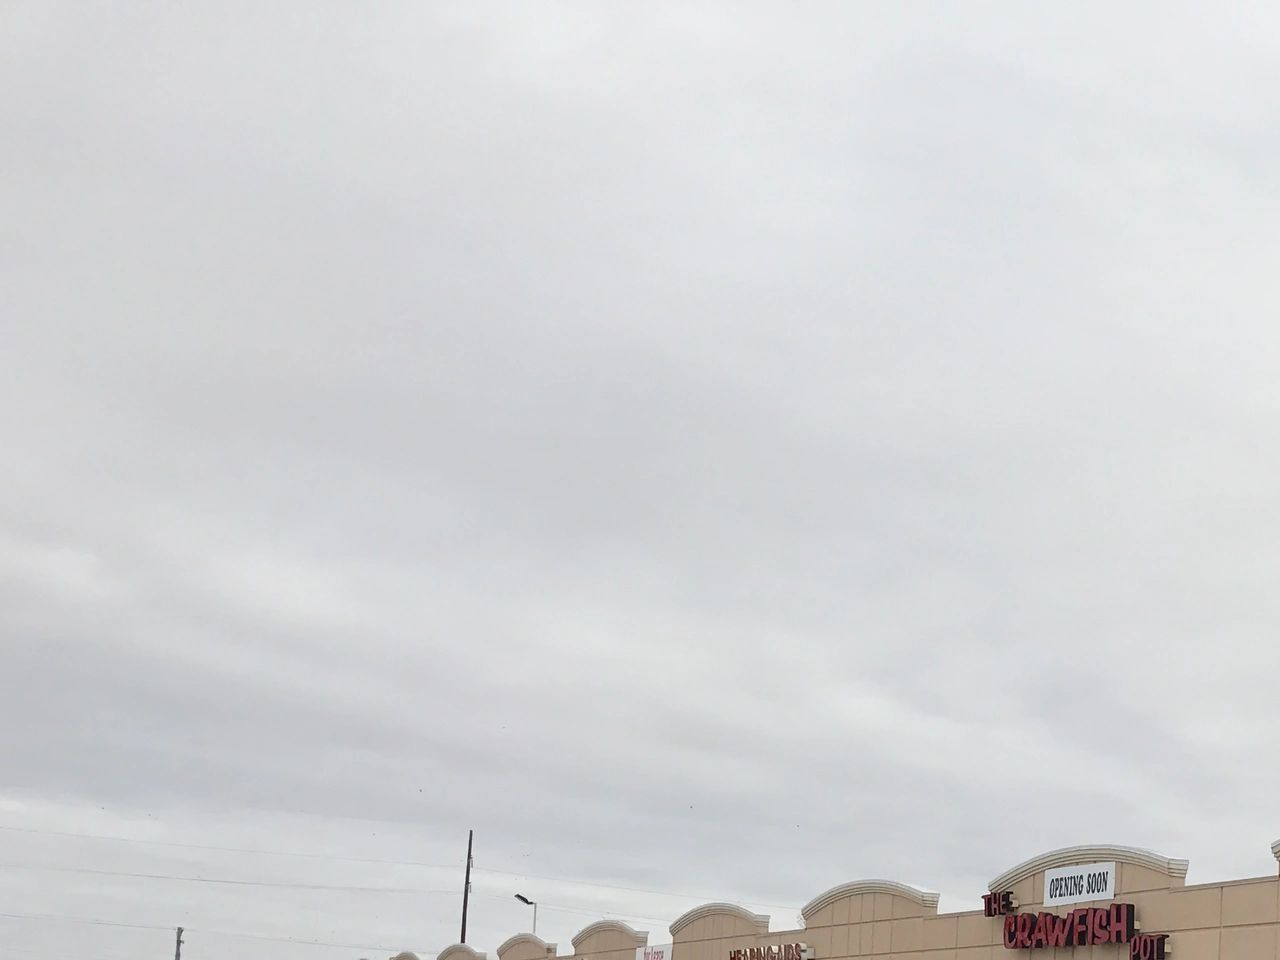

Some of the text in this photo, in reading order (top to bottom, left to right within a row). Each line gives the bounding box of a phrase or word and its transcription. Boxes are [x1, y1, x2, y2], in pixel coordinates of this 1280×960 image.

[1049, 871, 1109, 899] OPENING SOON
[982, 891, 1013, 917] THE
[1003, 903, 1134, 949] CRAWFISH
